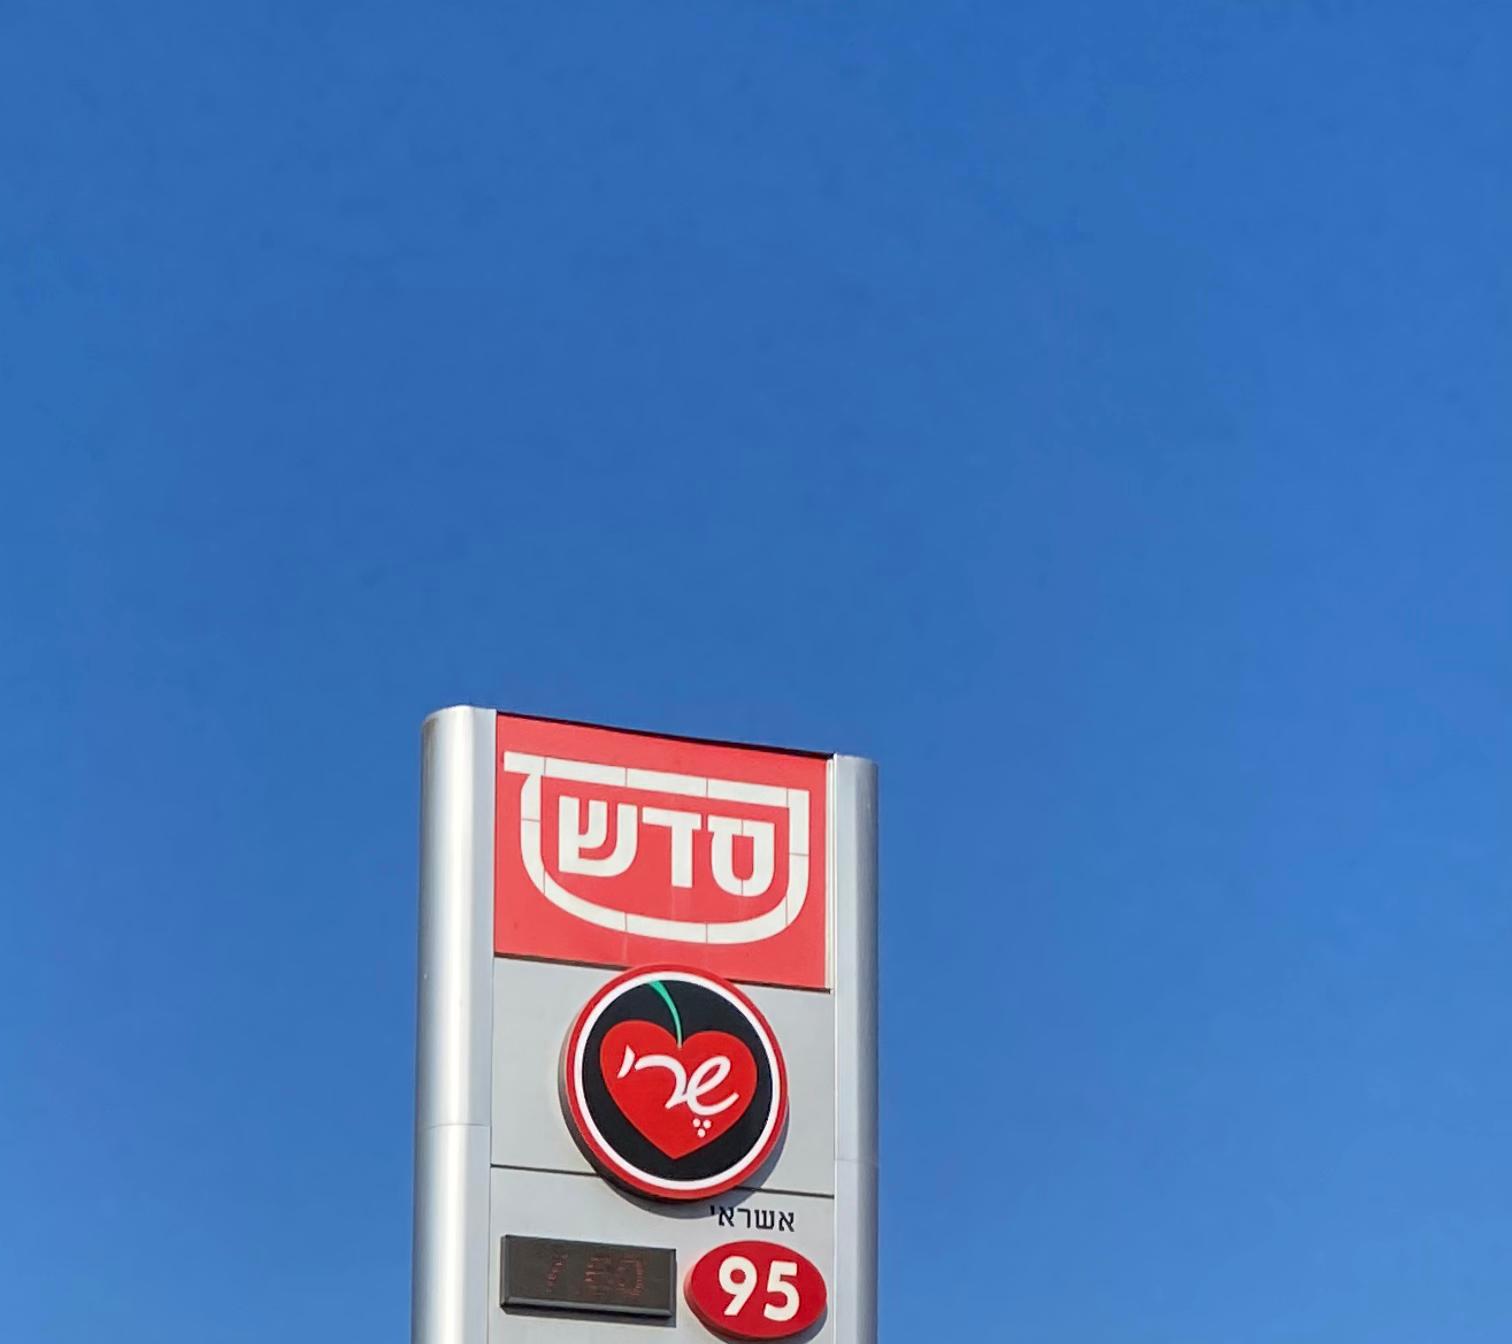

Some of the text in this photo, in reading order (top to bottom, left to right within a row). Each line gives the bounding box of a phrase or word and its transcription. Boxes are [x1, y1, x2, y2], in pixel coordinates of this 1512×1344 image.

[558, 795, 776, 897] סדש
[617, 1046, 740, 1118] שרי
[710, 1205, 795, 1232] אשראי
[718, 1255, 800, 1322] 95
